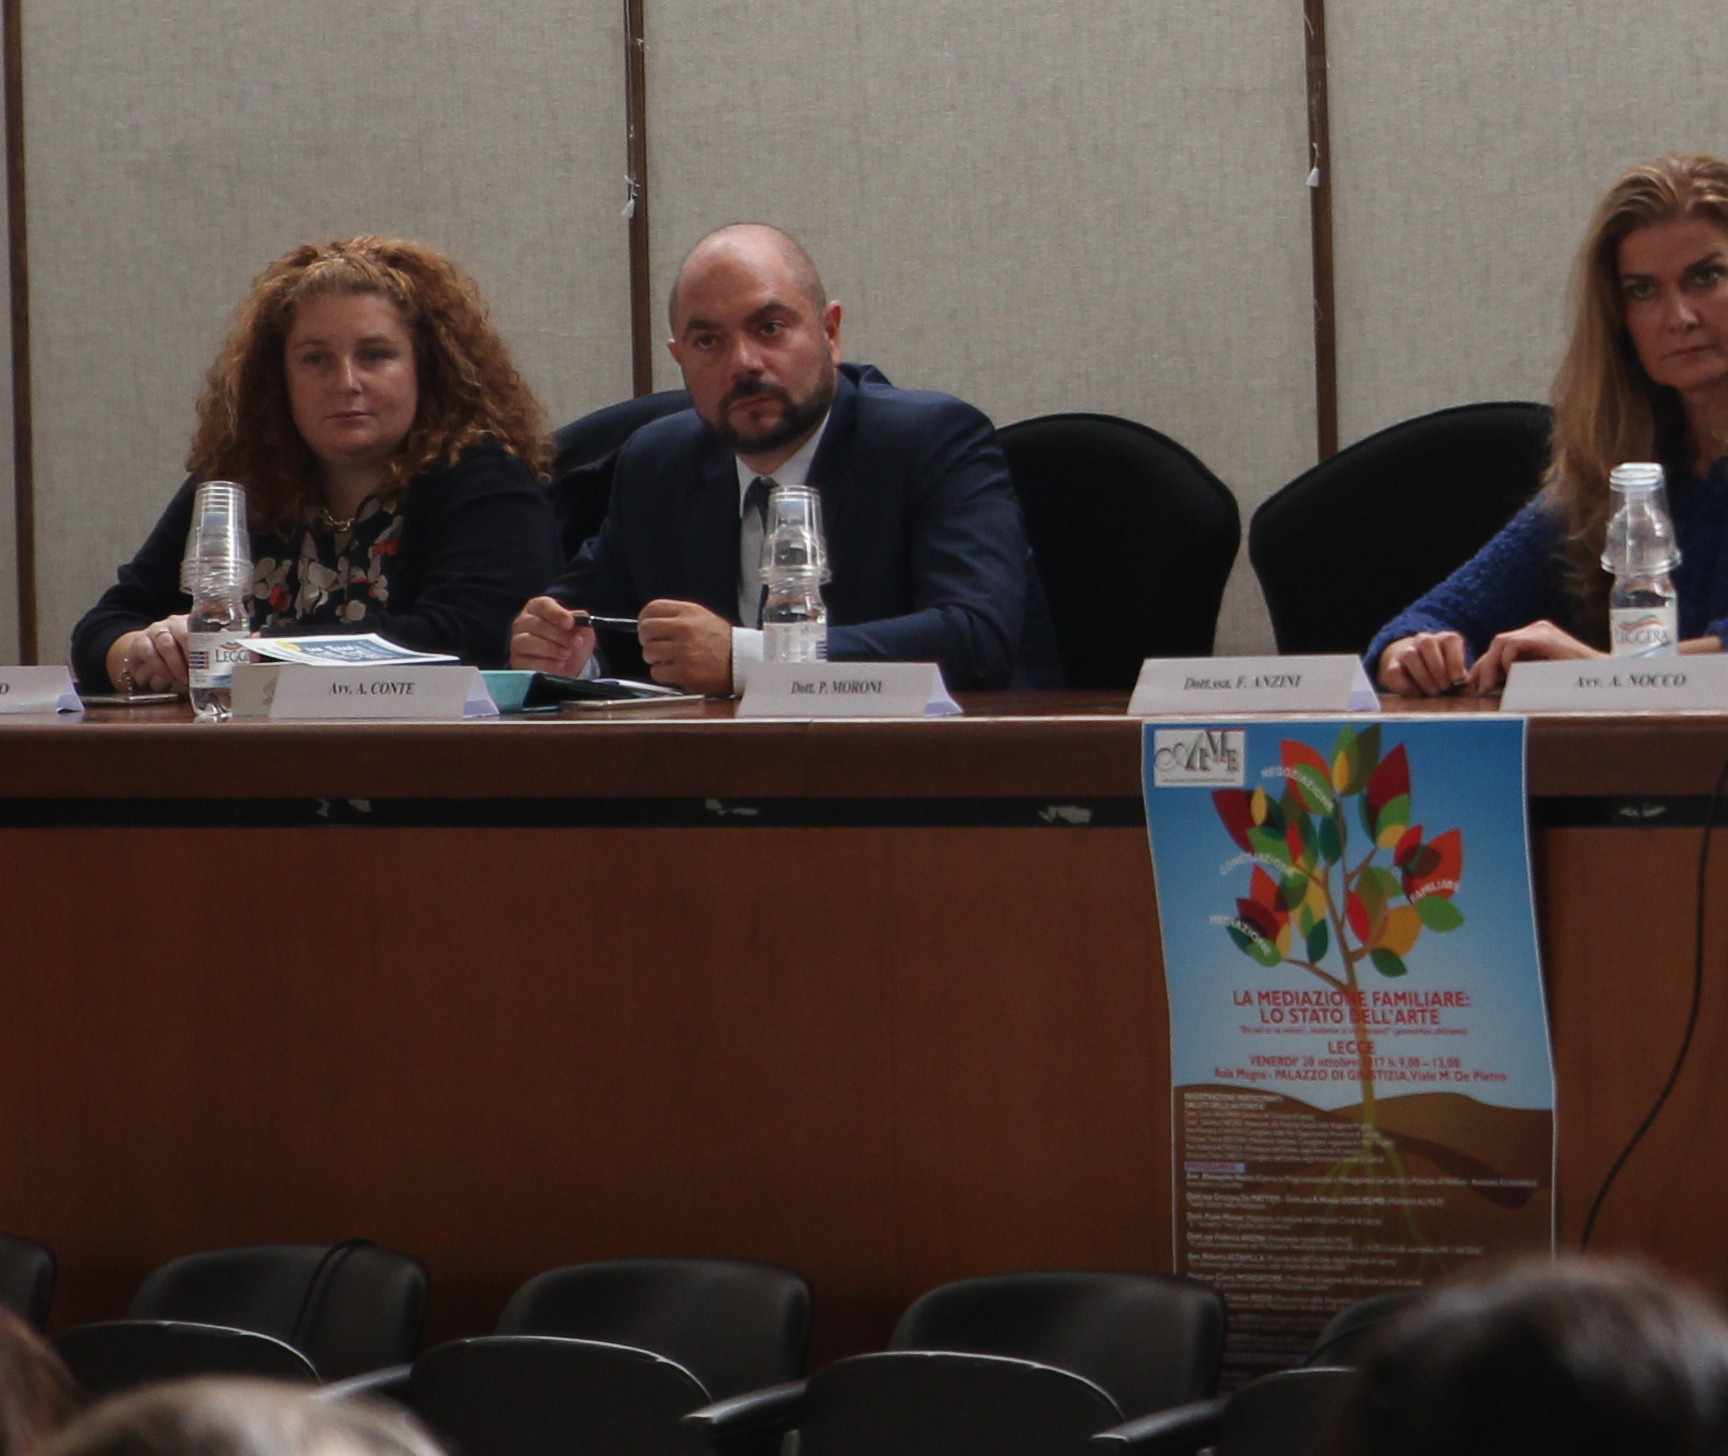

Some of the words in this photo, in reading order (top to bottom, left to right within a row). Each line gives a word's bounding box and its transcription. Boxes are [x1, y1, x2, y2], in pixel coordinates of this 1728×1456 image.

[329, 682, 353, 695] Avv.
[371, 682, 415, 695] CONTE
[791, 680, 815, 695] Dott.
[832, 680, 883, 693] MORONI
[1253, 675, 1302, 689] ANZINI
[1574, 676, 1604, 689] Avv.
[1628, 674, 1687, 688] NOCCO
[1233, 991, 1252, 1006] LA
[1257, 991, 1366, 1006] MEDIAZIONE
[1373, 991, 1471, 1007] FAMILIARE:
[1260, 1008, 1284, 1024] LO
[1289, 1008, 1344, 1024] STATO
[1349, 1008, 1440, 1025] DELL'ARTE
[1327, 1040, 1375, 1055] LECCE
[1275, 1069, 1328, 1081] PALAZZO
[1331, 1070, 1343, 1081] DI
[1454, 1071, 1470, 1082] De
